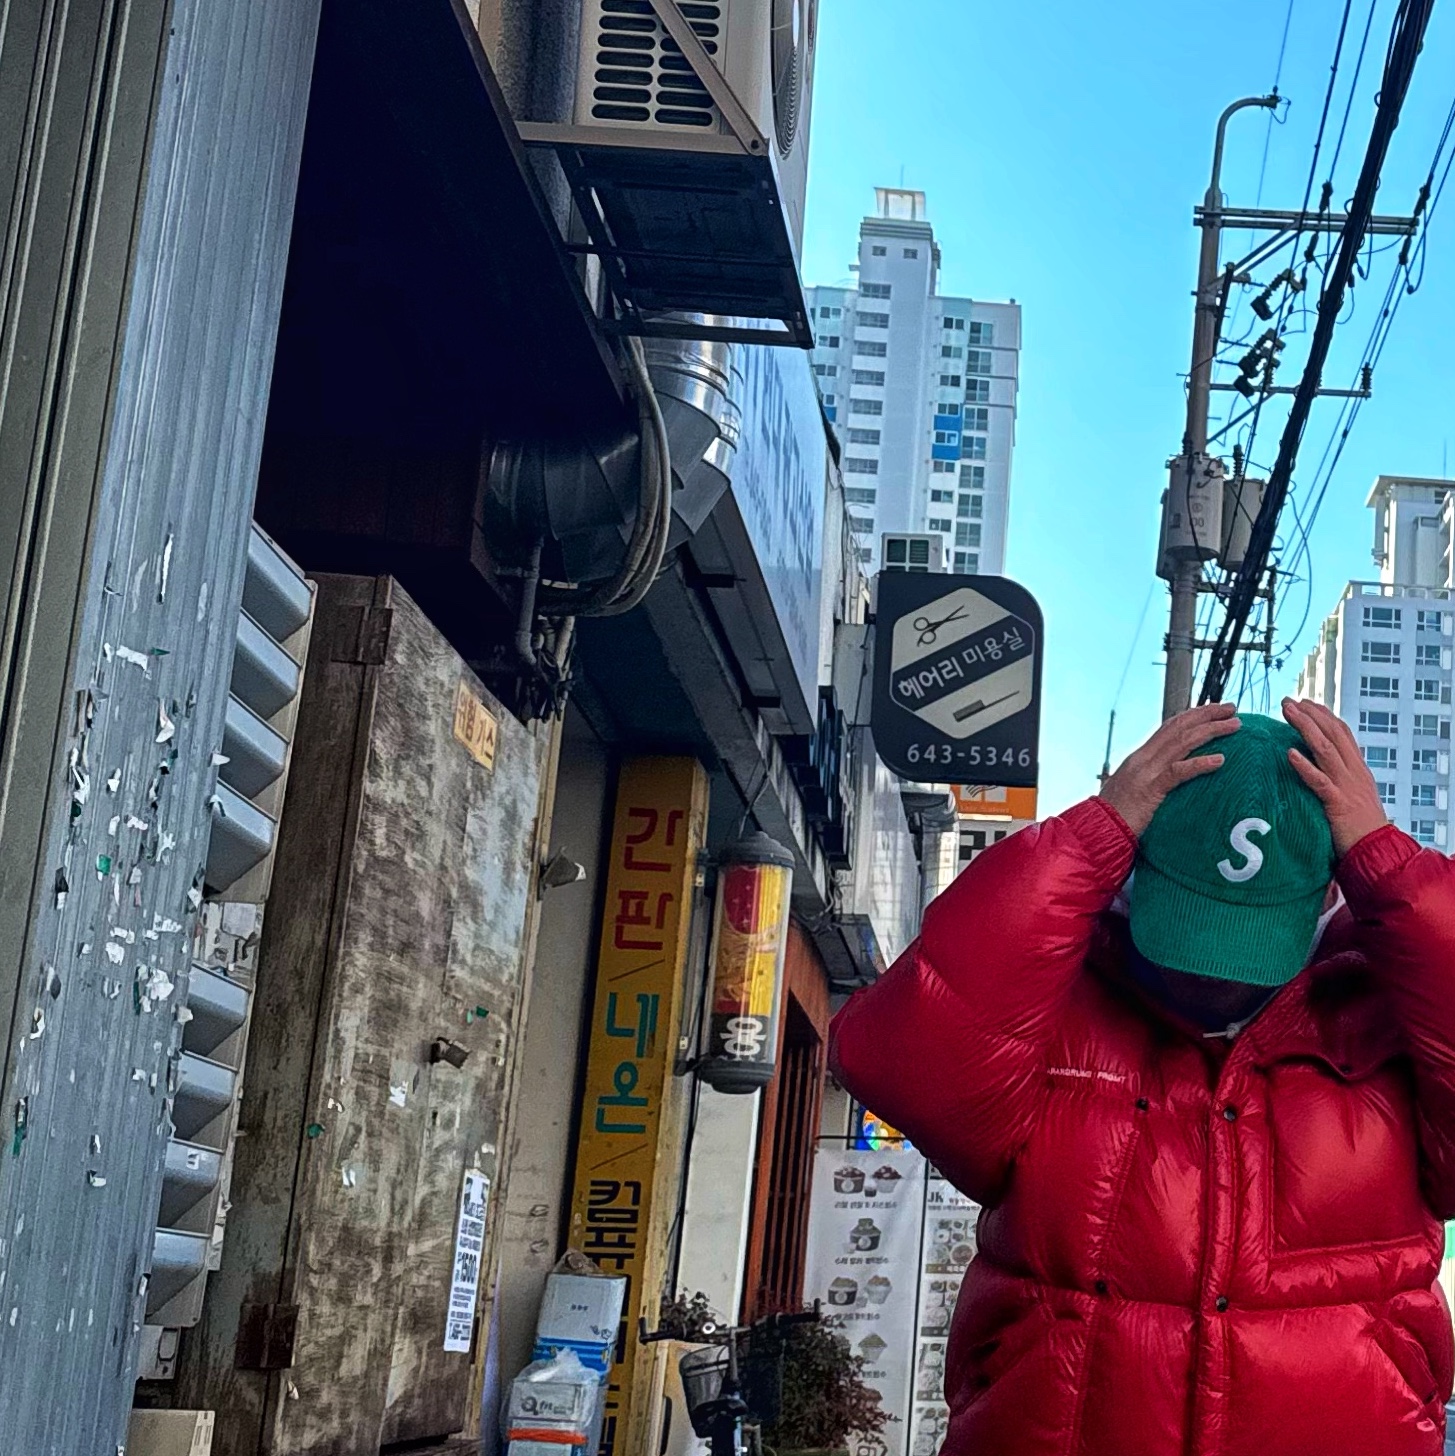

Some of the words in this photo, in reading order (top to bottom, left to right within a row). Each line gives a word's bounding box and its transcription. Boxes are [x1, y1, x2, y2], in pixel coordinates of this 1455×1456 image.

[898, 656, 965, 700] 헤어리
[962, 627, 1026, 665] 미용실
[907, 743, 1031, 767] 643-5346
[613, 806, 685, 951] 간판
[1216, 817, 1272, 882] S
[594, 991, 660, 1135] 네온
